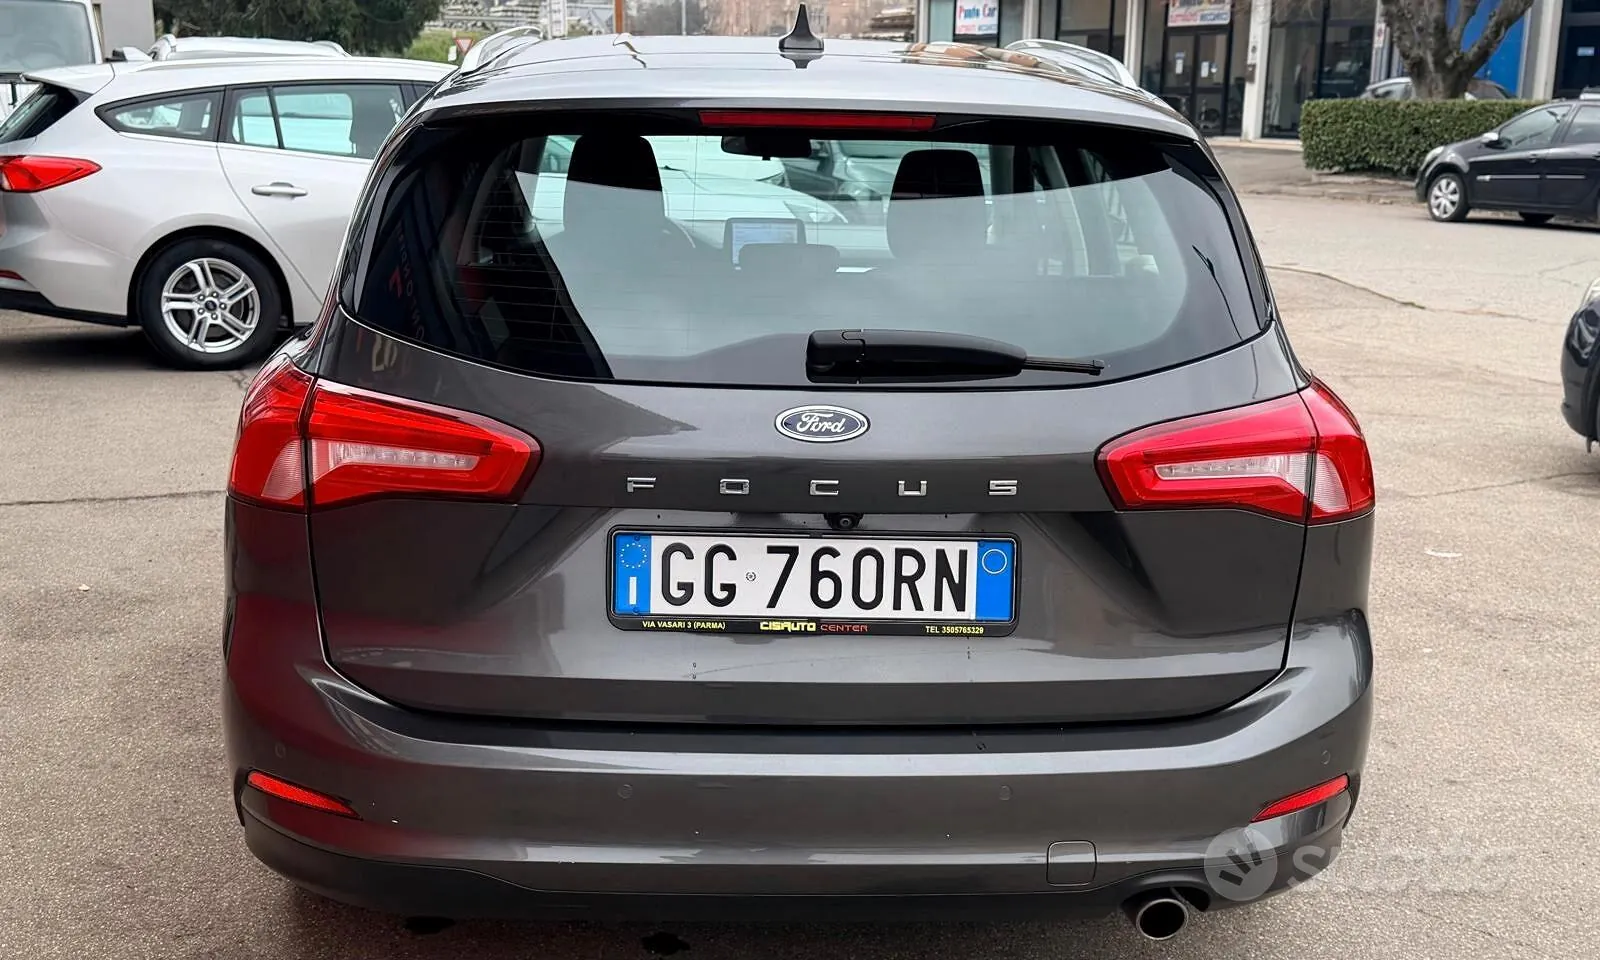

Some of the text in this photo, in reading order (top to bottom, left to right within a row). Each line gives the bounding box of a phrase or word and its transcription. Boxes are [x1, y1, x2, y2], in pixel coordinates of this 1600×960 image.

[982, 4, 997, 17] Car
[796, 412, 846, 433] Ford
[626, 477, 1018, 496] FOCUS
[657, 621, 685, 629] VASARI
[693, 621, 726, 630] (PARMA)
[760, 621, 869, 632] CISAUTO CENTER
